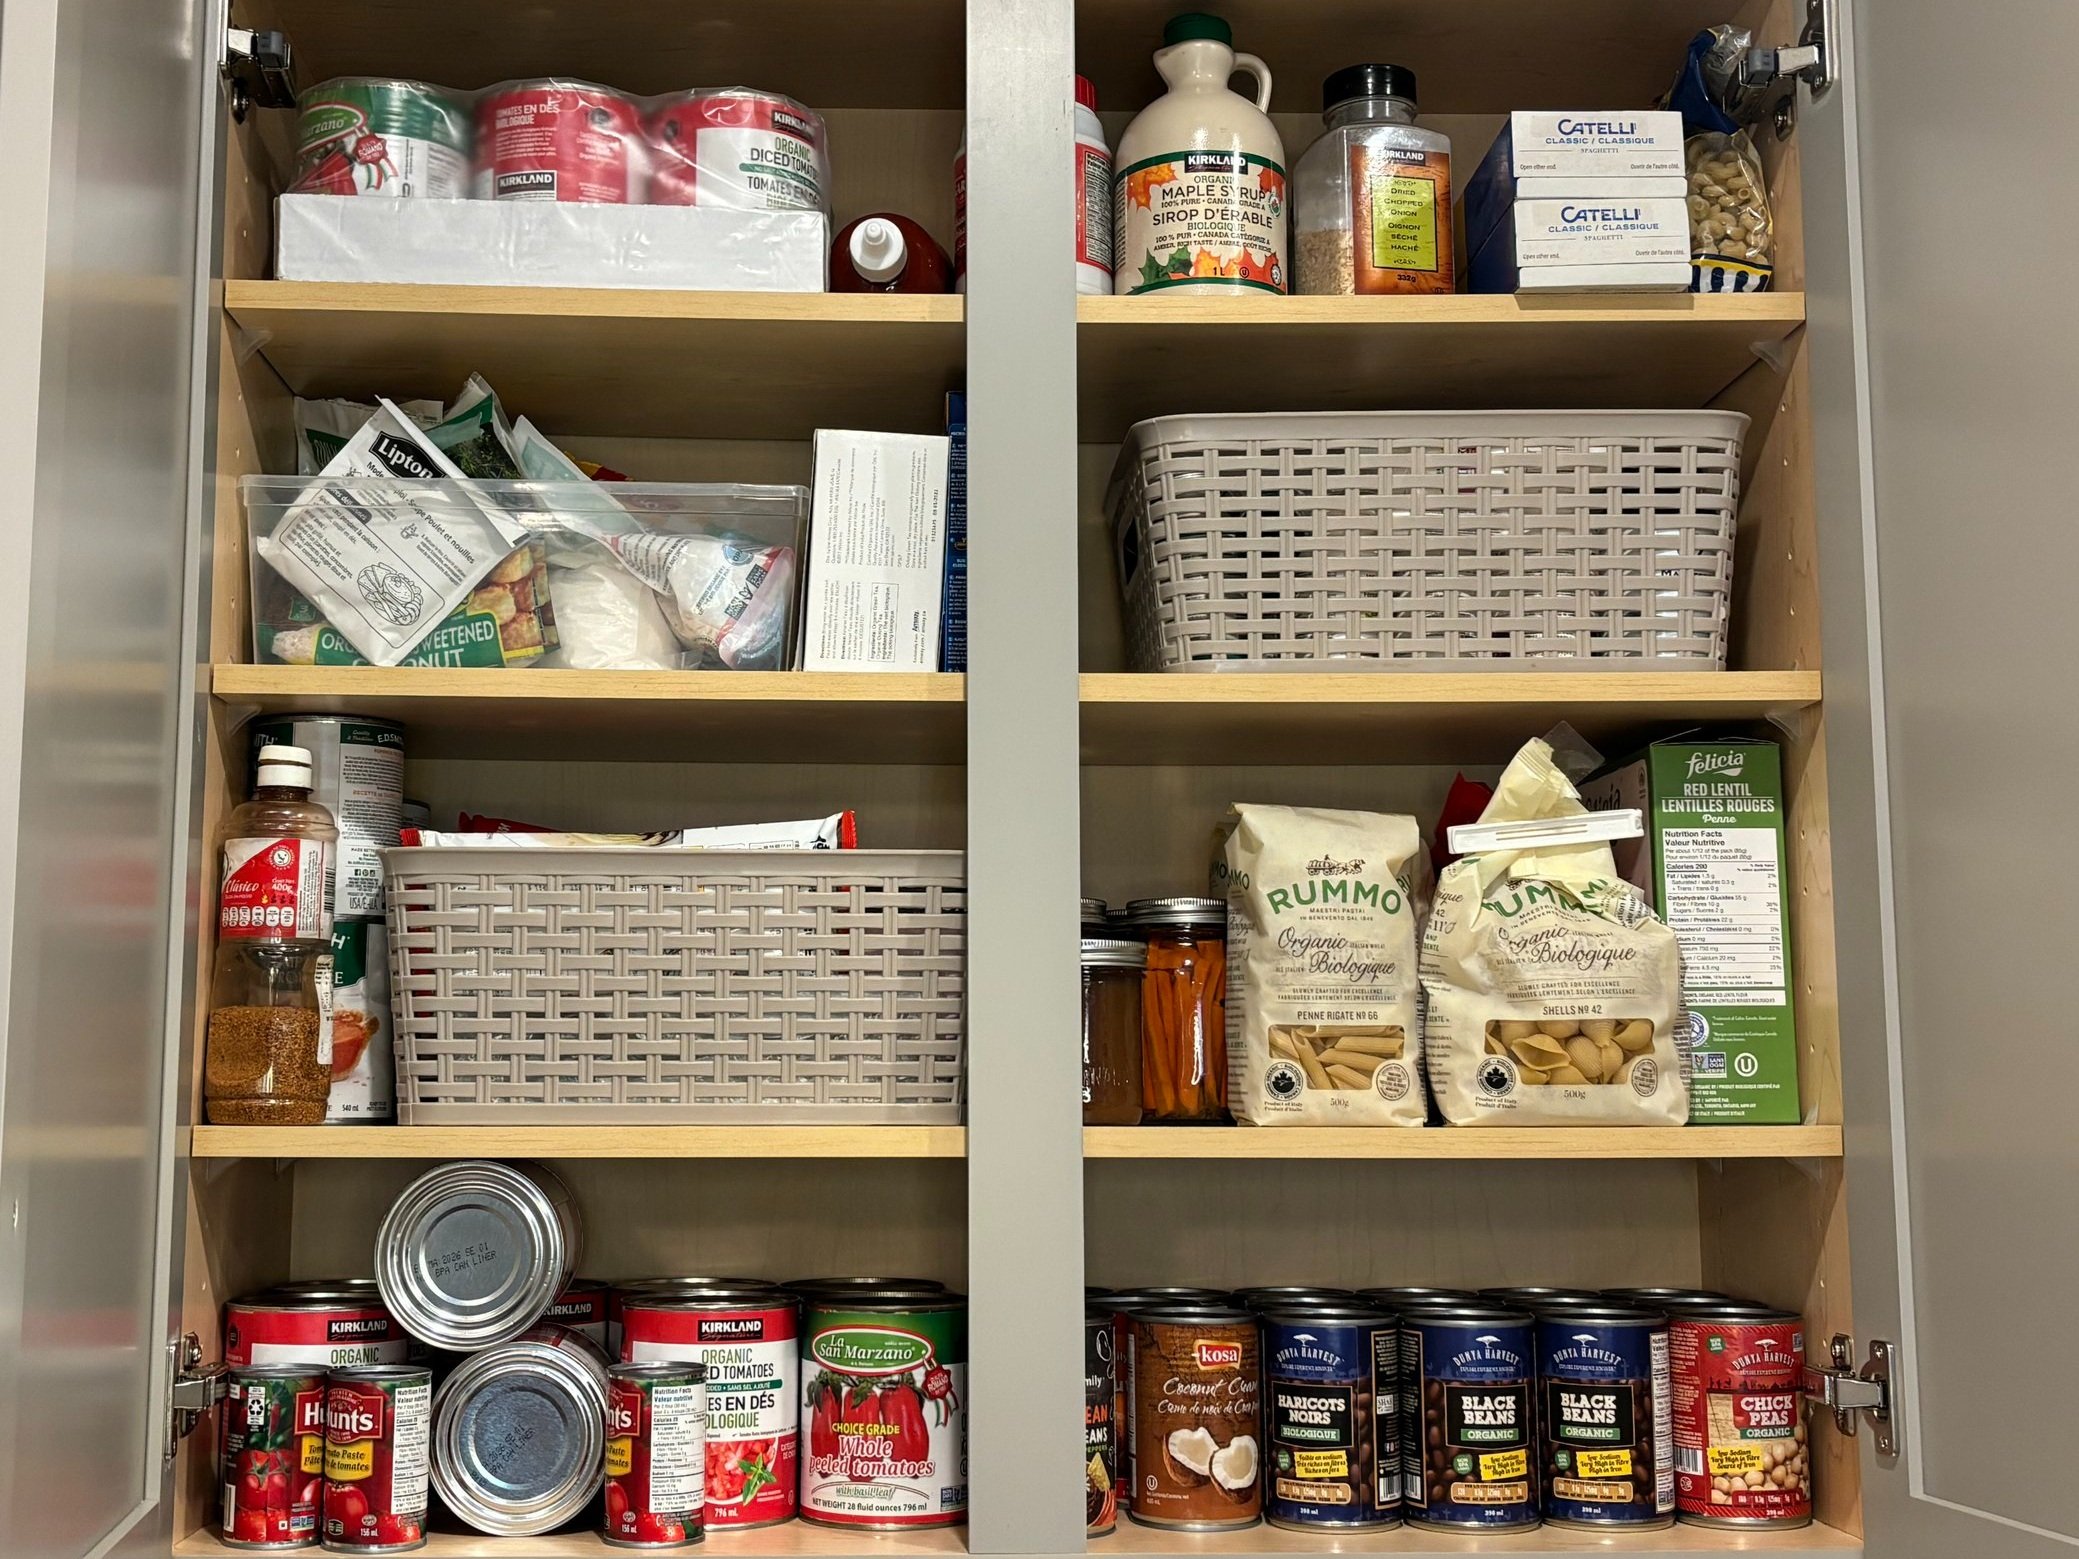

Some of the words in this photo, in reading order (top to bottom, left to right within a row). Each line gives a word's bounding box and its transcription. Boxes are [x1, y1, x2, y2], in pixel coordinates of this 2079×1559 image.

[1558, 118, 1635, 136] CATELLI
[1545, 137, 1588, 145] CLASSIC
[1598, 137, 1654, 145] CLASSIQUE
[750, 147, 790, 167] DICED
[774, 136, 811, 163] ORGANIC
[500, 173, 553, 187] KIRKLAND
[1162, 185, 1215, 201] MAPLE
[1391, 187, 1416, 196] DRIED
[1181, 198, 1201, 206] PURE
[1384, 198, 1424, 207] CHOPPED
[1153, 209, 1199, 226] SIROP
[1204, 206, 1273, 229] D'ÉRABLE
[1390, 209, 1417, 217] ONION
[1561, 206, 1639, 224] CATELLI
[1387, 222, 1421, 231] OIGNON
[1548, 225, 1592, 233] CLASSIC
[1602, 223, 1659, 231] CLASSIQUE
[1198, 231, 1230, 239] CANADA
[378, 436, 431, 480] Lipton
[1685, 749, 1744, 780] felicia
[1684, 782, 1708, 797] RED
[1711, 782, 1752, 797] LENTIL
[1662, 799, 1724, 813] LENTILLES
[1727, 799, 1775, 813] ROUGES
[1702, 814, 1737, 824] Penne
[1665, 830, 1699, 838] Nutrition
[1700, 830, 1723, 838] Facts
[1266, 878, 1402, 915] RUMMO
[1277, 925, 1348, 958] Organic
[1498, 926, 1570, 955] Organic
[1529, 940, 1637, 972] Biologique
[1308, 950, 1396, 984] Biologique
[1297, 1011, 1324, 1021] PENNE
[1326, 1011, 1354, 1021] RIGATE
[1367, 1011, 1378, 1020] 66
[1542, 1005, 1576, 1015] SHELLS
[1590, 1004, 1602, 1015] 42
[1330, 1097, 1349, 1108] 500g
[1563, 1089, 1586, 1100] 500g
[331, 1320, 388, 1334] KIRKLAND
[701, 1320, 762, 1335] KIRKLAND
[830, 1334, 844, 1347] La
[330, 1346, 380, 1365] ORGANIC
[702, 1348, 753, 1365] ORGANIC
[819, 1343, 842, 1359] San
[844, 1345, 914, 1361] Marzano
[1202, 1345, 1237, 1363] kosa
[1276, 1347, 1299, 1364] DUNYA
[1300, 1345, 1341, 1366] HARVEST
[1453, 1349, 1482, 1366] DUNYA
[1484, 1347, 1519, 1366] HARVEST
[1553, 1347, 1578, 1364] DUNYA
[1581, 1345, 1622, 1366] HARVEST
[1732, 1354, 1761, 1370] DUNYA
[1764, 1351, 1796, 1368] HARVEST
[724, 1363, 774, 1380] TOMATOES
[654, 1387, 677, 1396] Nutrition
[727, 1383, 742, 1391] SANS
[725, 1396, 745, 1411] EN
[750, 1391, 775, 1409] DÉS
[1277, 1393, 1346, 1412] HARICOTS
[1461, 1395, 1517, 1411] BLACK
[1559, 1392, 1617, 1410] BLACK
[1740, 1394, 1793, 1411] CHICK
[326, 1402, 374, 1433] unt's
[1288, 1408, 1331, 1425] NOIRS
[1463, 1410, 1516, 1425] BEANS
[1562, 1407, 1617, 1424] BEANS
[1749, 1410, 1789, 1426] PEAS
[832, 1422, 864, 1436] CHOICE
[865, 1423, 900, 1436] GRADE
[1282, 1426, 1337, 1440] BIOLOGIQUE
[1467, 1429, 1514, 1440] ORGANIC
[1565, 1427, 1613, 1438] ORGANIC
[1746, 1427, 1791, 1438] ORGANIC
[838, 1435, 894, 1458] Whole
[809, 1454, 851, 1478] peeled
[852, 1458, 936, 1477] tomatoes
[714, 1507, 727, 1518] 796
[812, 1497, 822, 1507] NET
[822, 1498, 846, 1509] WEIGHT
[847, 1502, 856, 1511] 28
[856, 1502, 874, 1512] fluid
[874, 1504, 902, 1512] ounces
[903, 1503, 917, 1512] 796
[917, 1502, 927, 1511] ml
